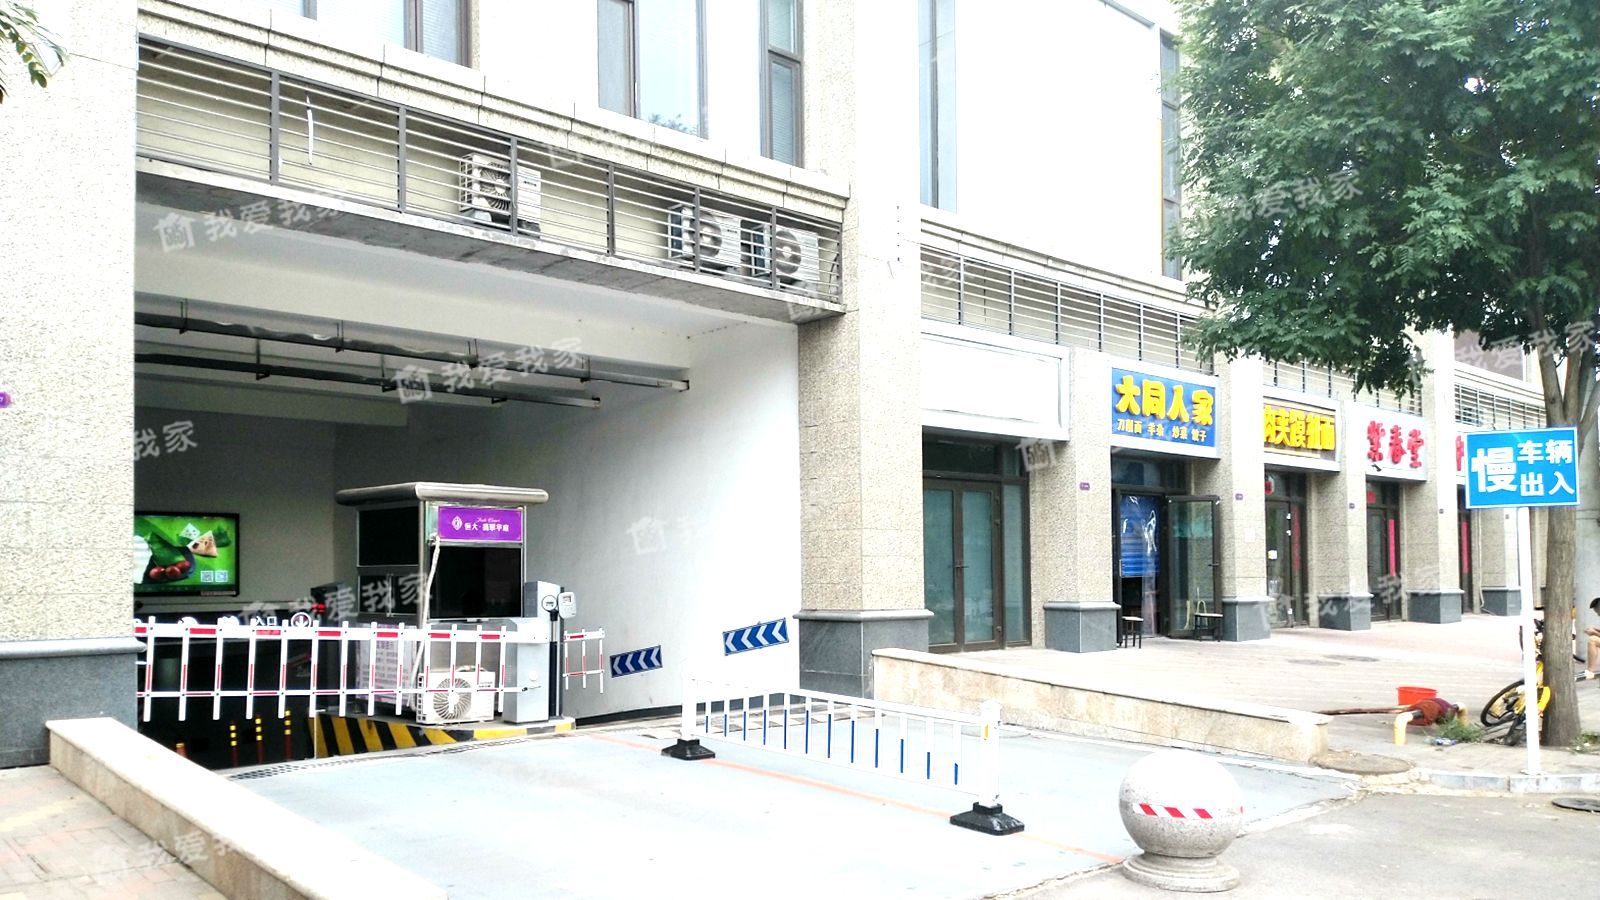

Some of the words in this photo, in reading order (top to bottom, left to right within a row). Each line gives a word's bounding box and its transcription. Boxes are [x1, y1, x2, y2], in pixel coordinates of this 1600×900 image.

[1115, 375, 1214, 425] 大同人家
[1471, 446, 1518, 493] 慢
[1517, 439, 1574, 465] 车辆
[1520, 471, 1576, 497] 出入
